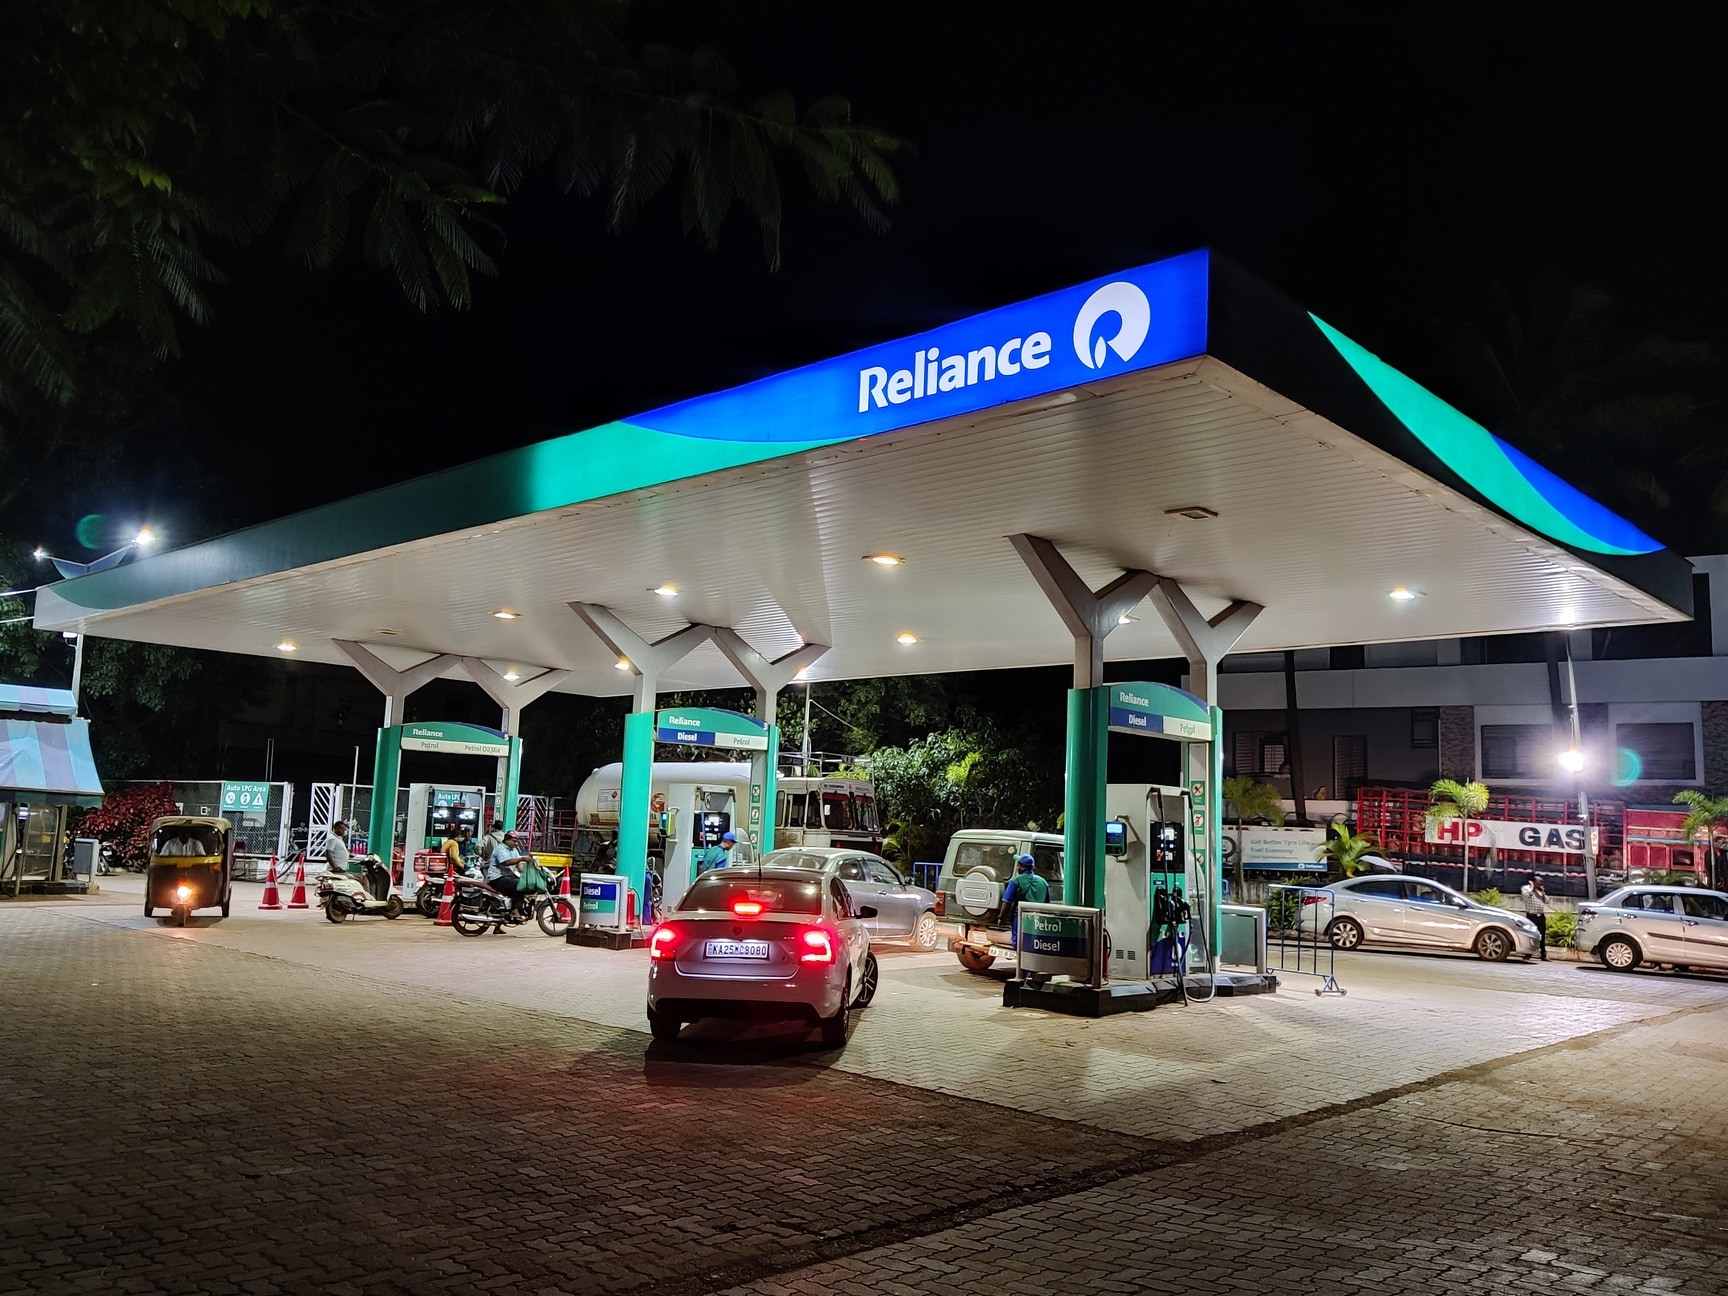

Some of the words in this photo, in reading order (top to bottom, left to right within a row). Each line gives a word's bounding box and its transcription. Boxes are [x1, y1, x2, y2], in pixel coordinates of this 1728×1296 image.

[858, 331, 1052, 413] Reliance
[1119, 691, 1149, 707] Reliance
[669, 715, 701, 727] Reliance
[762, 722, 768, 731] 3
[1128, 714, 1147, 727] Diesel
[412, 728, 443, 737] Reliance
[677, 731, 697, 742] Diesel
[733, 737, 751, 746] Petrol
[421, 741, 439, 750] Petrol
[465, 744, 482, 753] Petrol
[482, 745, 490, 753] Oil
[1437, 821, 1483, 842] HP
[1518, 826, 1586, 851] GAS
[584, 886, 601, 896] Diesel
[1034, 918, 1062, 932] Petrol
[1033, 939, 1060, 952] Diesel
